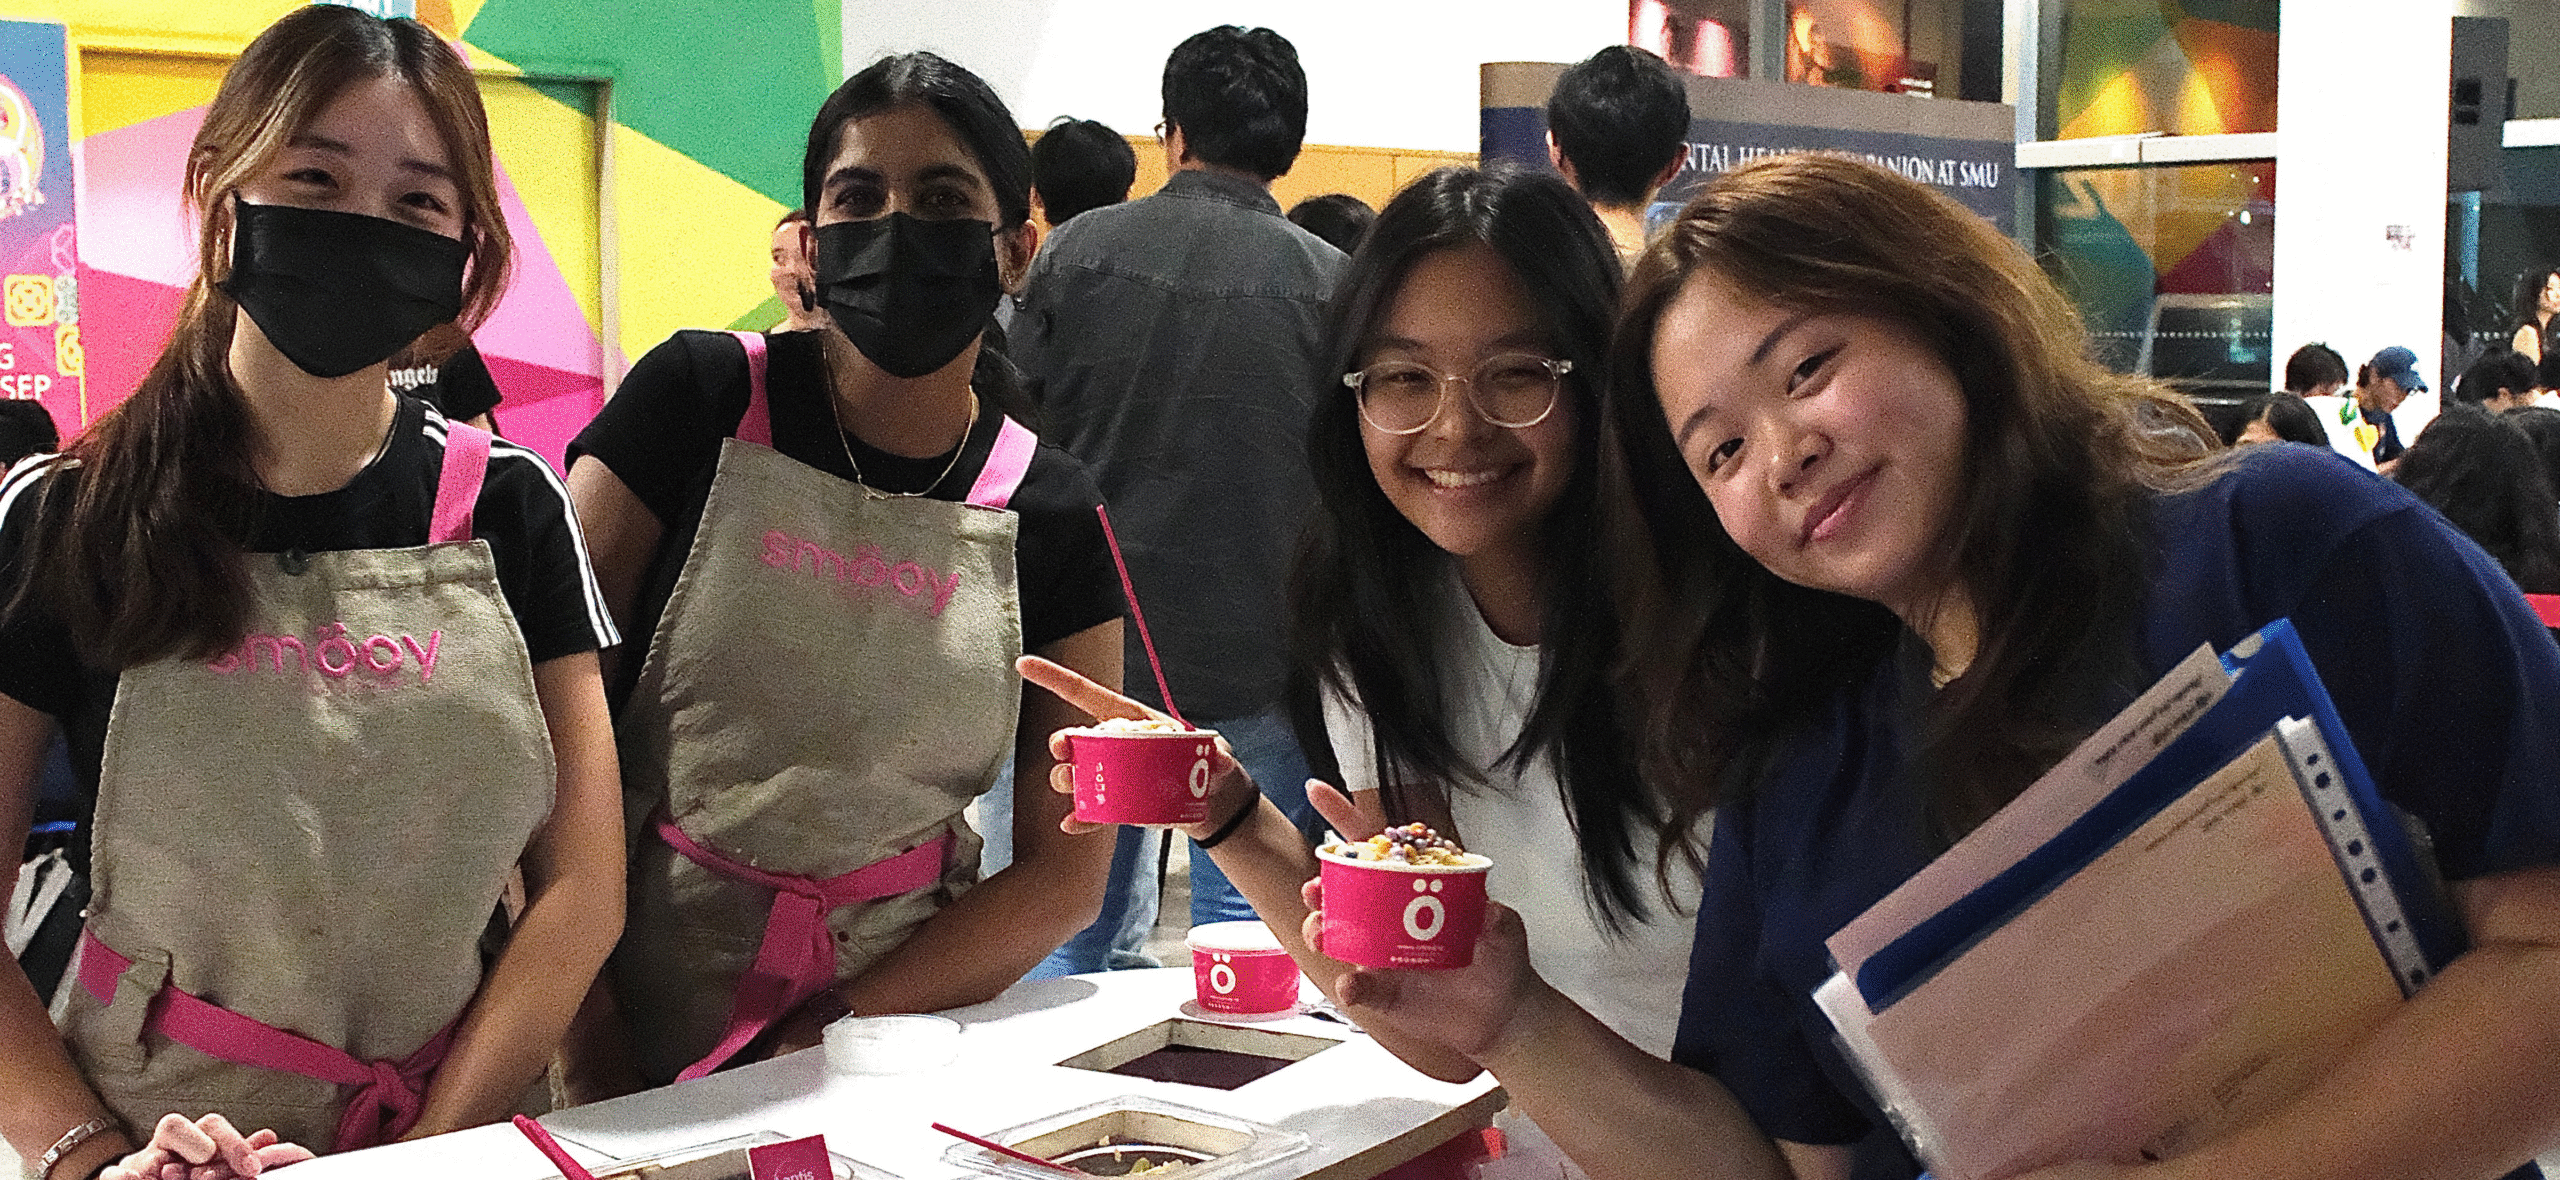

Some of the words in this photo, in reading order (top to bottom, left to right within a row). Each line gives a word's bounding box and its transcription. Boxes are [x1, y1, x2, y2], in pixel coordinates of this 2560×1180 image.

[1937, 159, 1957, 186] AT
[1960, 161, 1999, 188] SMU
[0, 374, 51, 400] SEP
